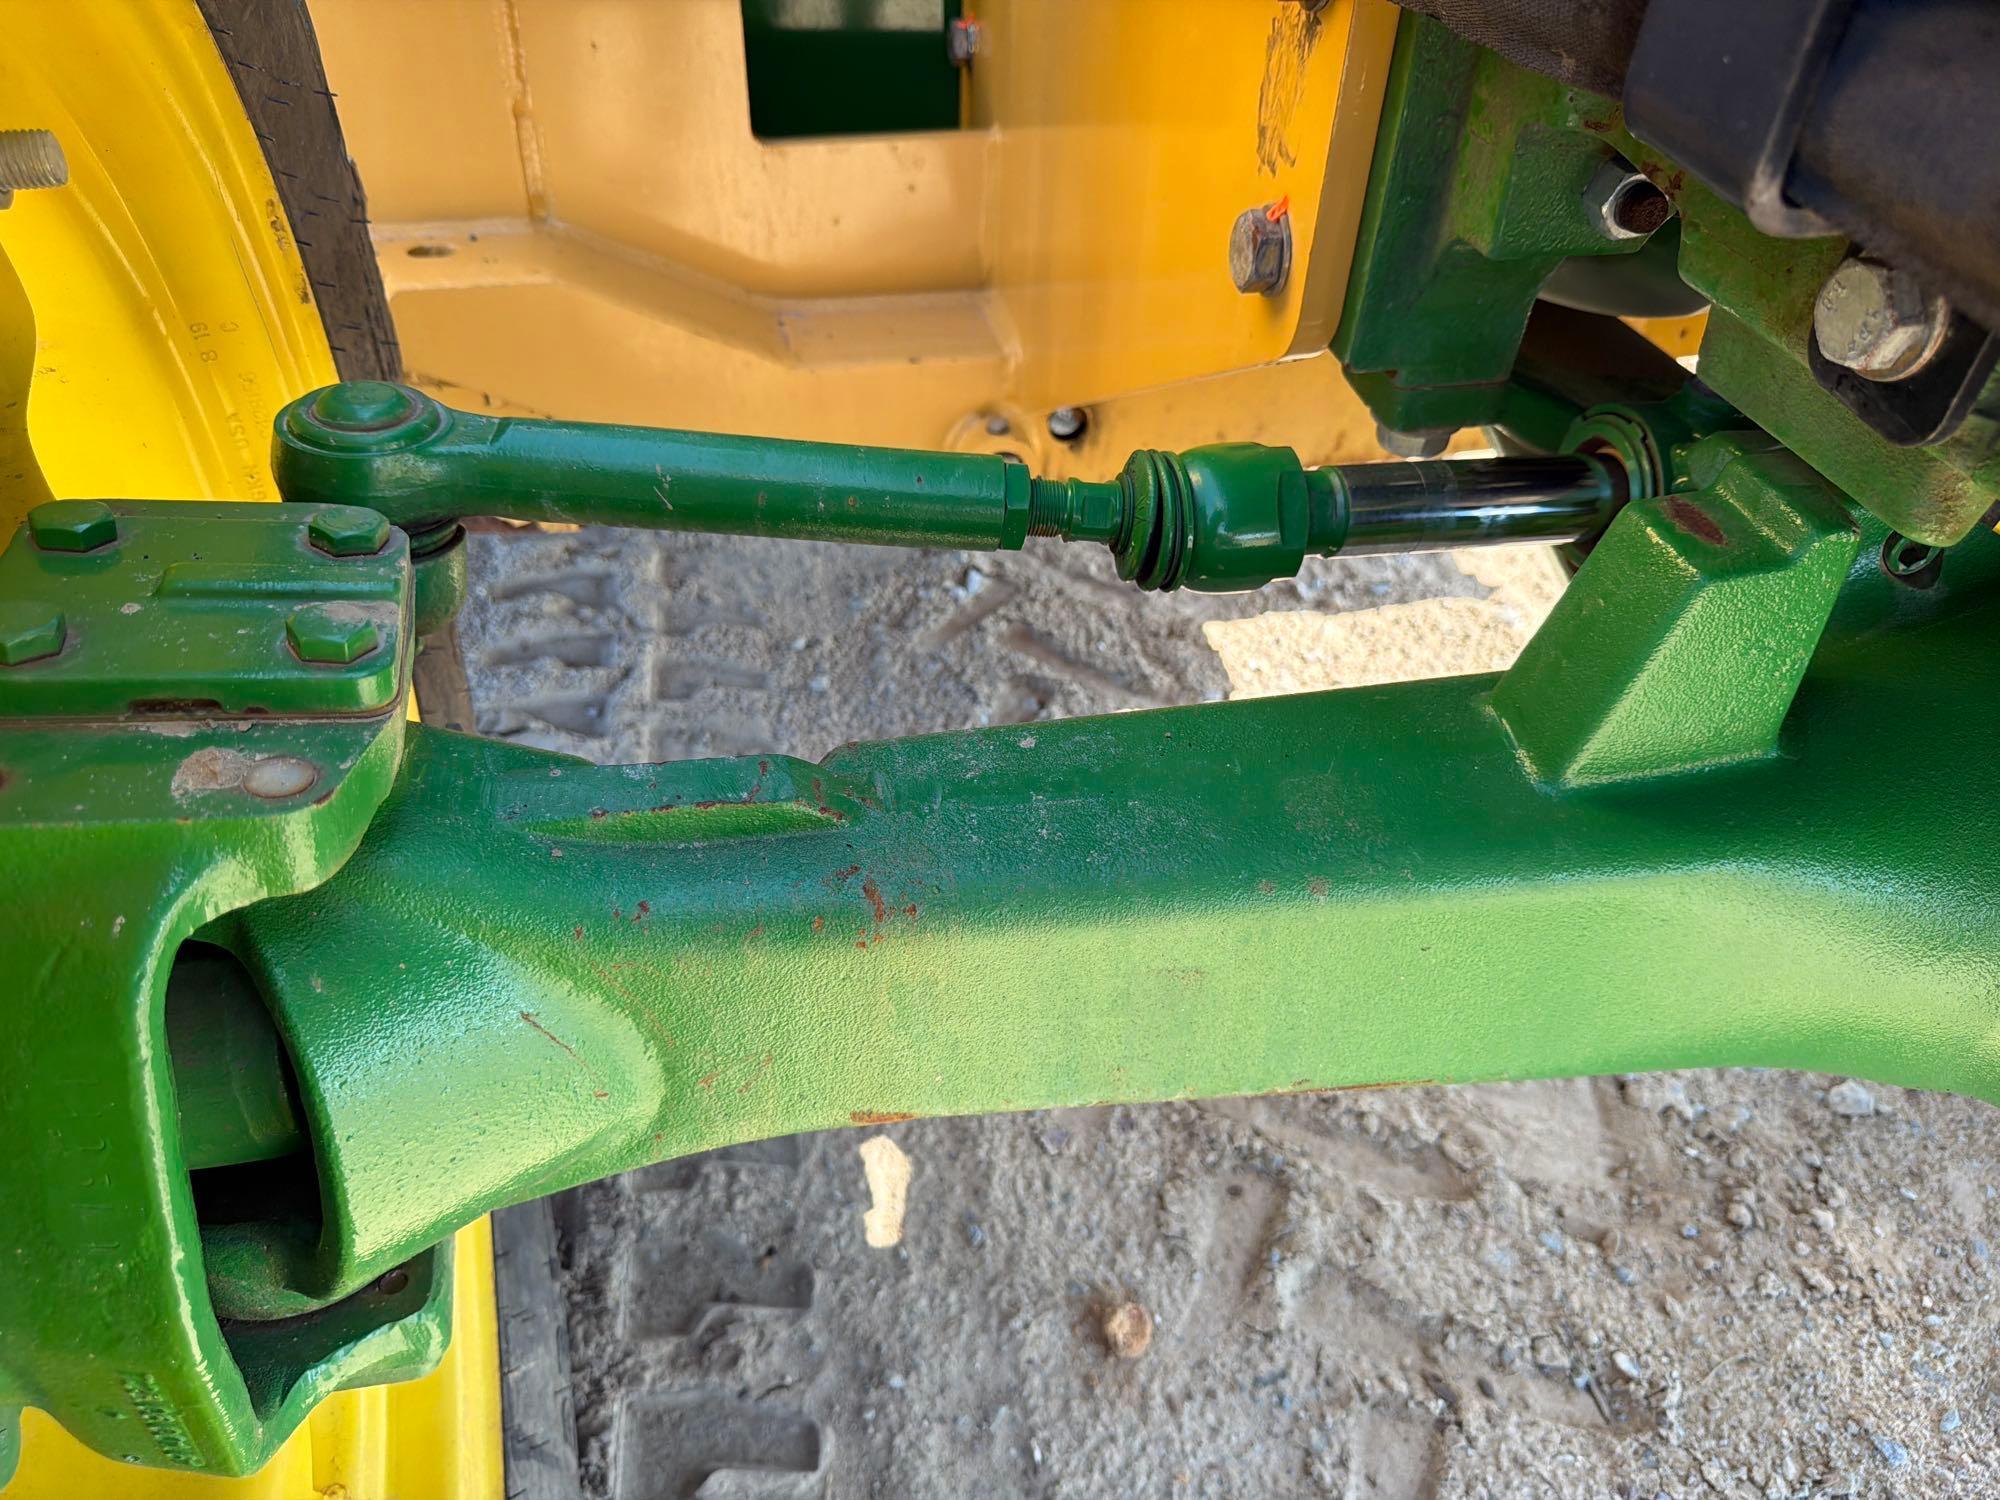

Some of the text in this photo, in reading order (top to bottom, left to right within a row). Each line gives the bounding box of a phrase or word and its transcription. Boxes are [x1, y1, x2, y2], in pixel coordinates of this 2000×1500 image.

[190, 322, 211, 340] 19
[200, 350, 218, 362] 8
[226, 411, 249, 449] USA
